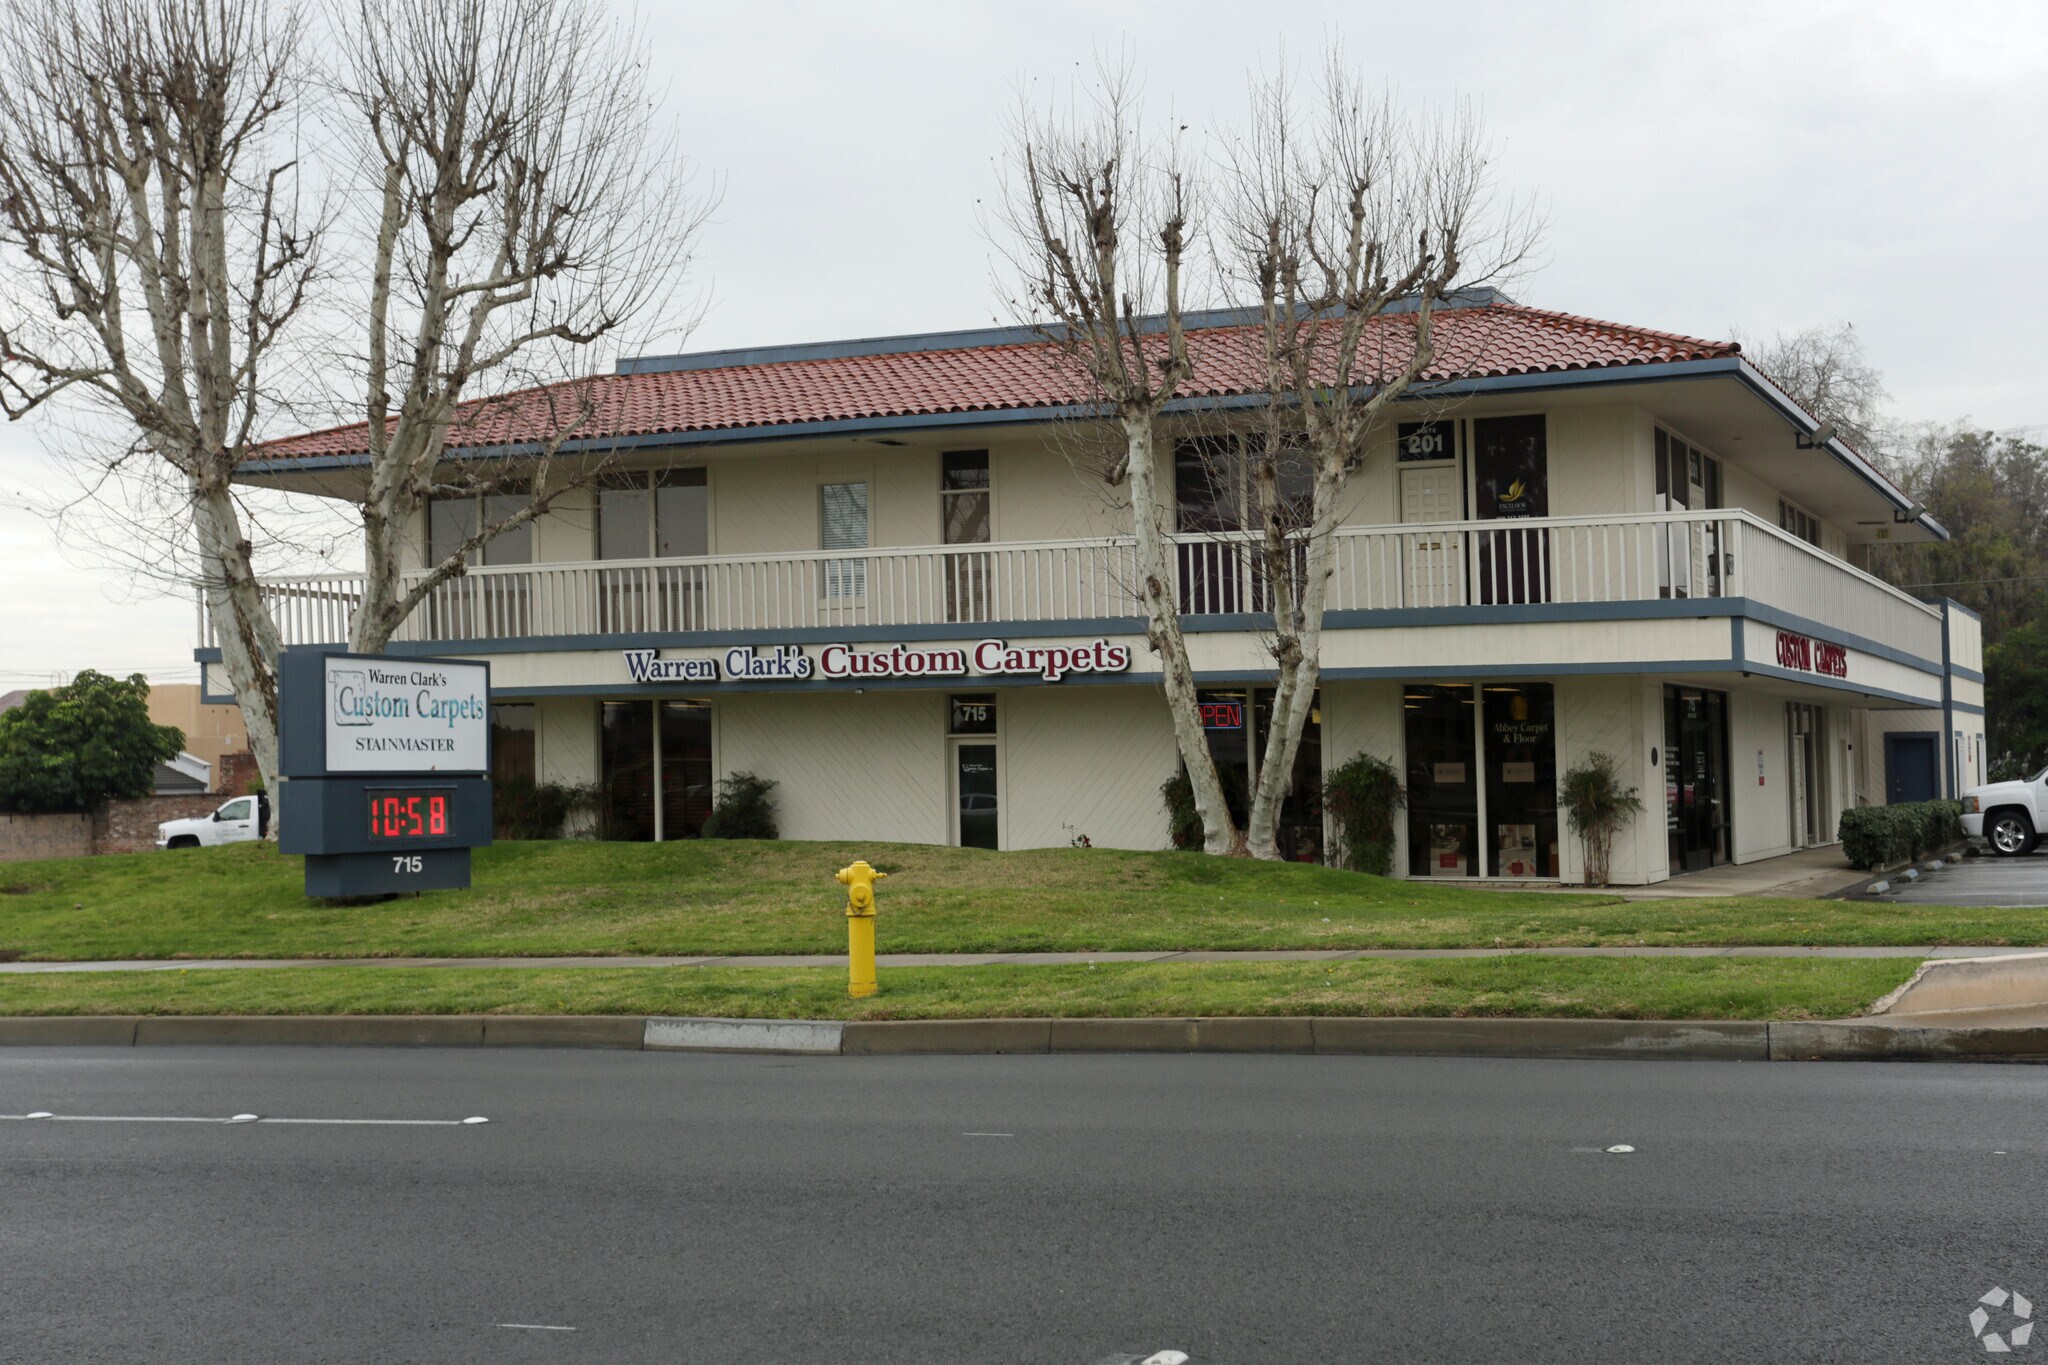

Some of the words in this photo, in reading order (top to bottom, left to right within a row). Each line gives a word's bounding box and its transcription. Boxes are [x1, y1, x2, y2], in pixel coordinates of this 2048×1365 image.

[1408, 434, 1443, 453] 201
[623, 651, 715, 679] Warren
[725, 647, 809, 677] Clark's
[821, 644, 964, 675] Custom
[974, 640, 1126, 678] Carpets
[1776, 630, 1812, 671] CUSTOM
[1814, 641, 1847, 678] CARPETS
[368, 668, 407, 686] Warren
[410, 671, 448, 687] Clark's
[339, 686, 410, 718] Custom
[416, 689, 484, 728] Carpets
[963, 706, 987, 721] 715
[1199, 705, 1239, 726] PEN
[1493, 723, 1518, 733] Abbey
[1520, 722, 1548, 733] Carpet
[355, 737, 456, 752] STAINMASTER
[1503, 734, 1511, 743] &
[1513, 733, 1537, 743] Floor
[372, 796, 447, 837] 10:58
[392, 856, 423, 874] 715
